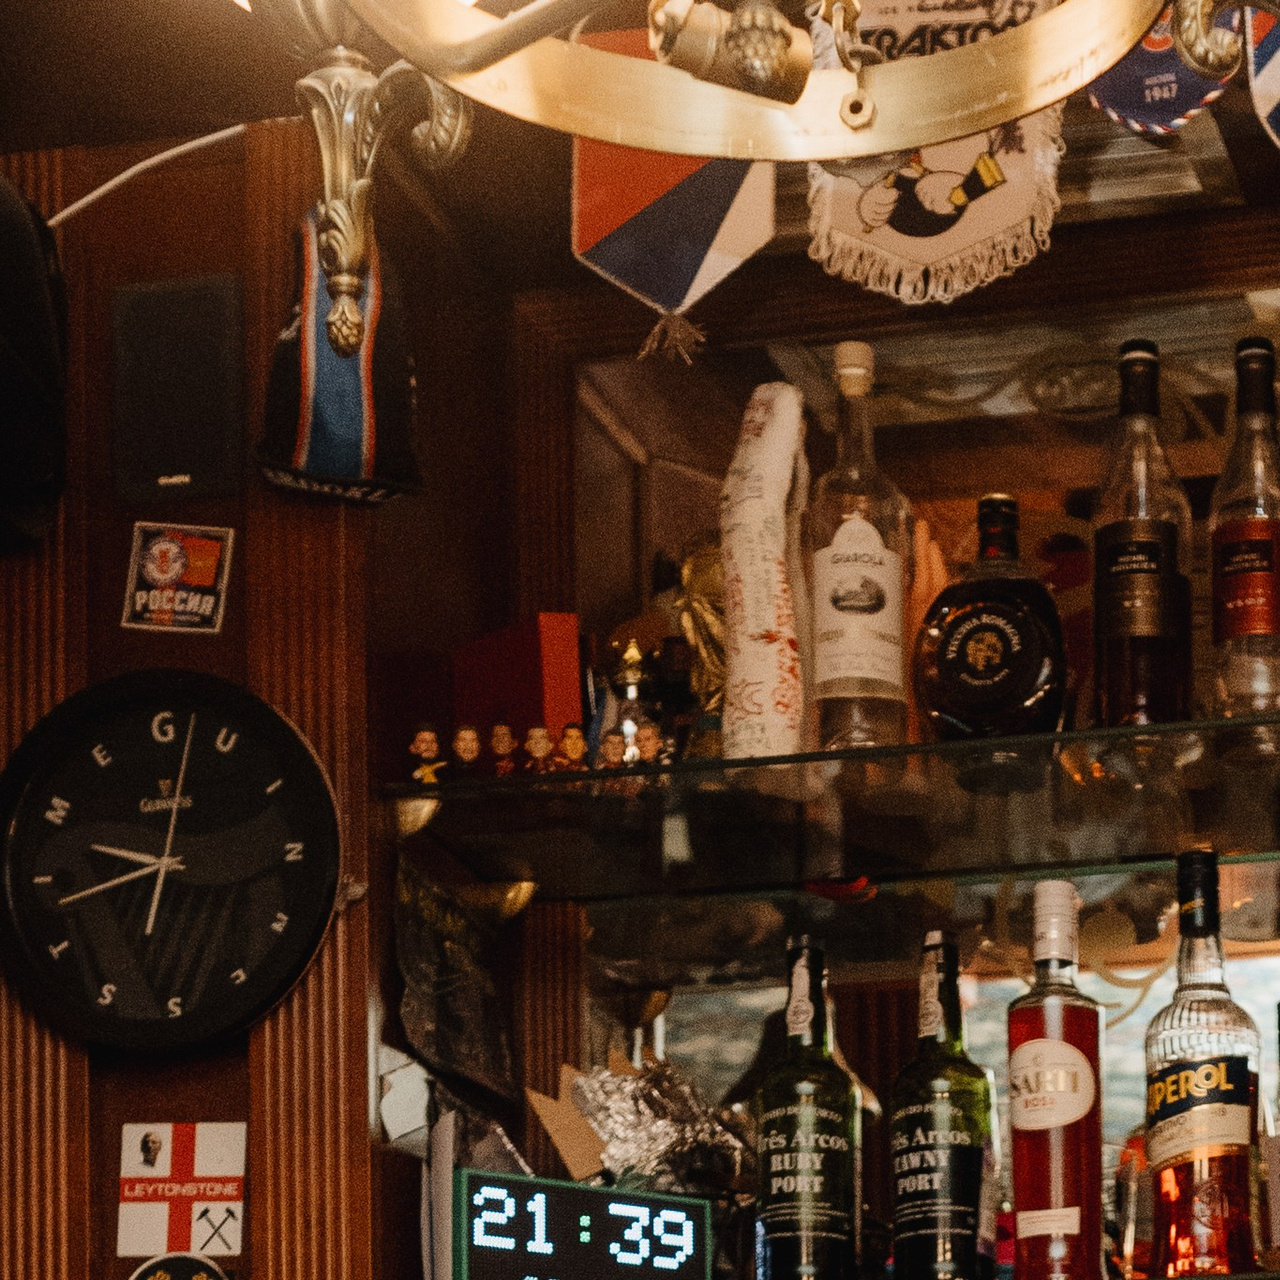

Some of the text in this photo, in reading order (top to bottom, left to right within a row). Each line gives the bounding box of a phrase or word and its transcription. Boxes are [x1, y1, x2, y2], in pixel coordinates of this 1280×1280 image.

[134, 588, 216, 616] РОССИЯ
[1010, 1067, 1080, 1098] SARTI
[770, 1152, 825, 1172] RUBY
[123, 1181, 240, 1197] LEYTONSTONE
[770, 1175, 825, 1196] PORT
[897, 1172, 944, 1196] PORT
